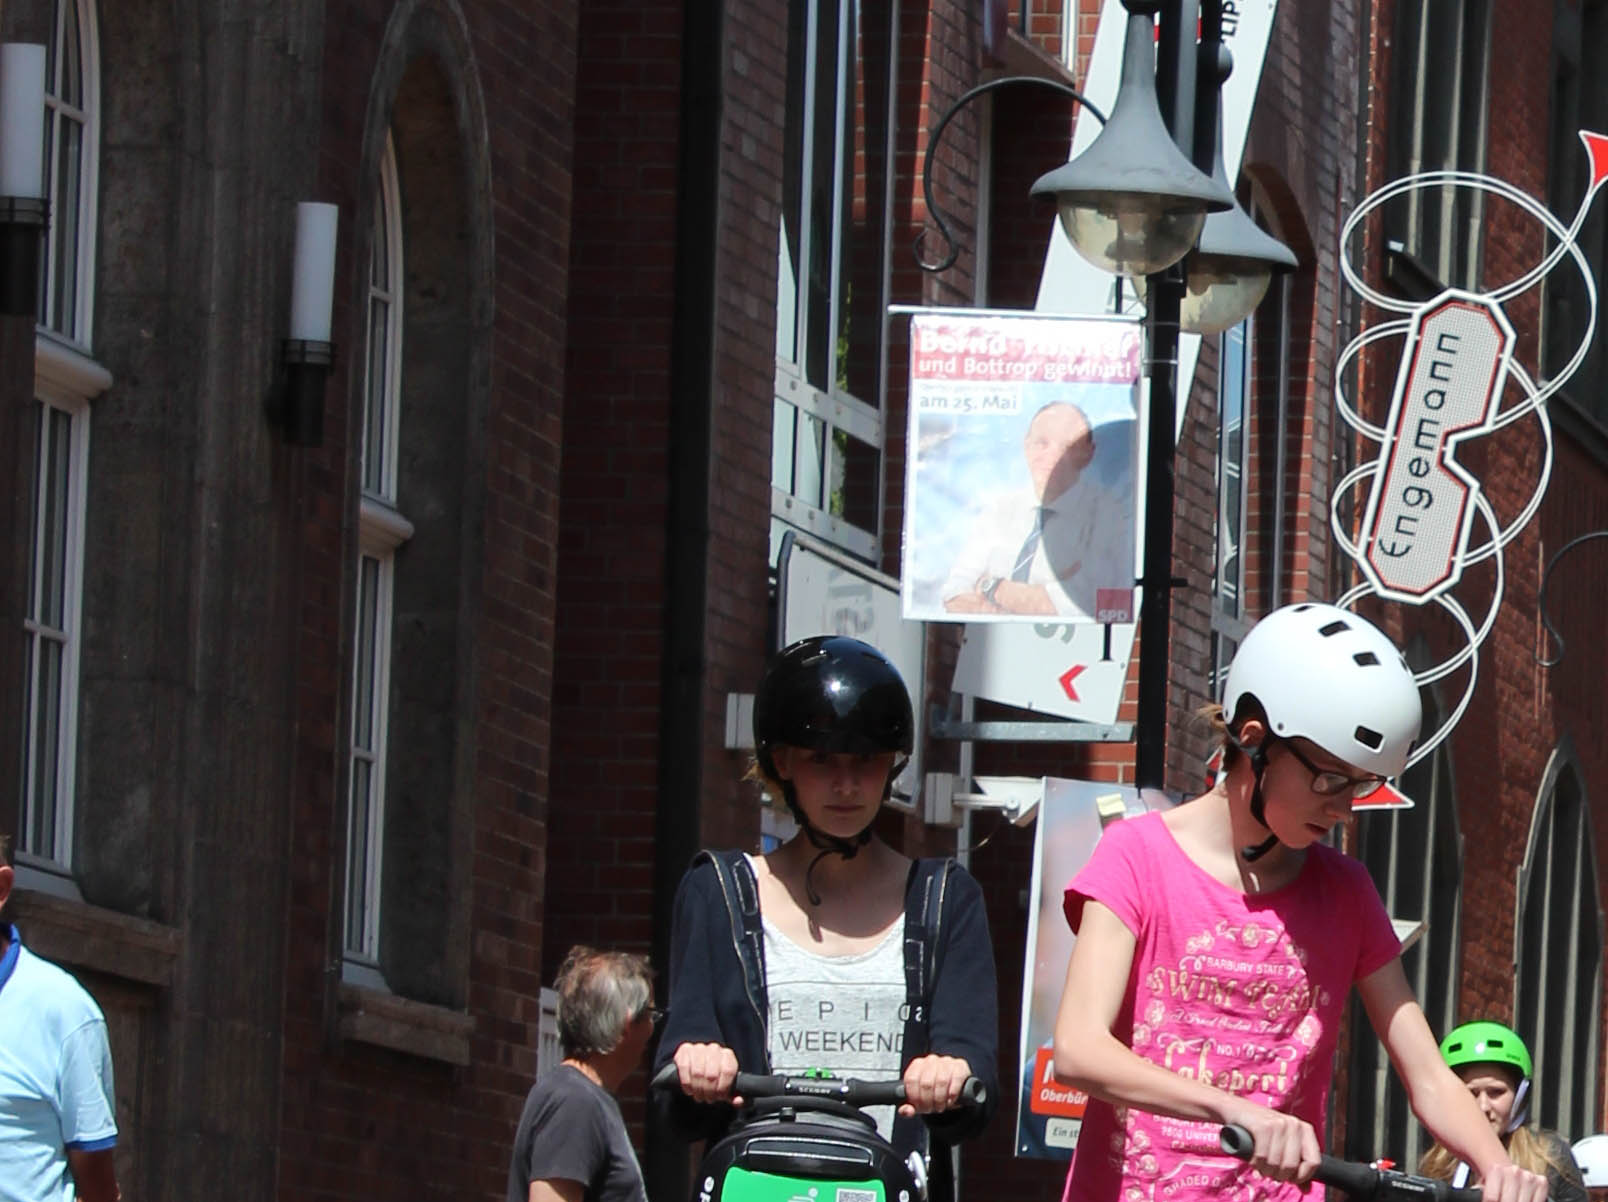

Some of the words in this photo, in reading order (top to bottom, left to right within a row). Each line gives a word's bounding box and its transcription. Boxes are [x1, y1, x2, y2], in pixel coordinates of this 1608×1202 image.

[919, 358, 955, 372] und
[963, 358, 1037, 377] Bottrop
[919, 396, 948, 409] am
[982, 395, 1017, 410] Mai
[1378, 331, 1461, 558] Engemann
[1098, 611, 1128, 622] SPD
[1256, 963, 1285, 976] STATE
[1146, 966, 1238, 1008] SWIM
